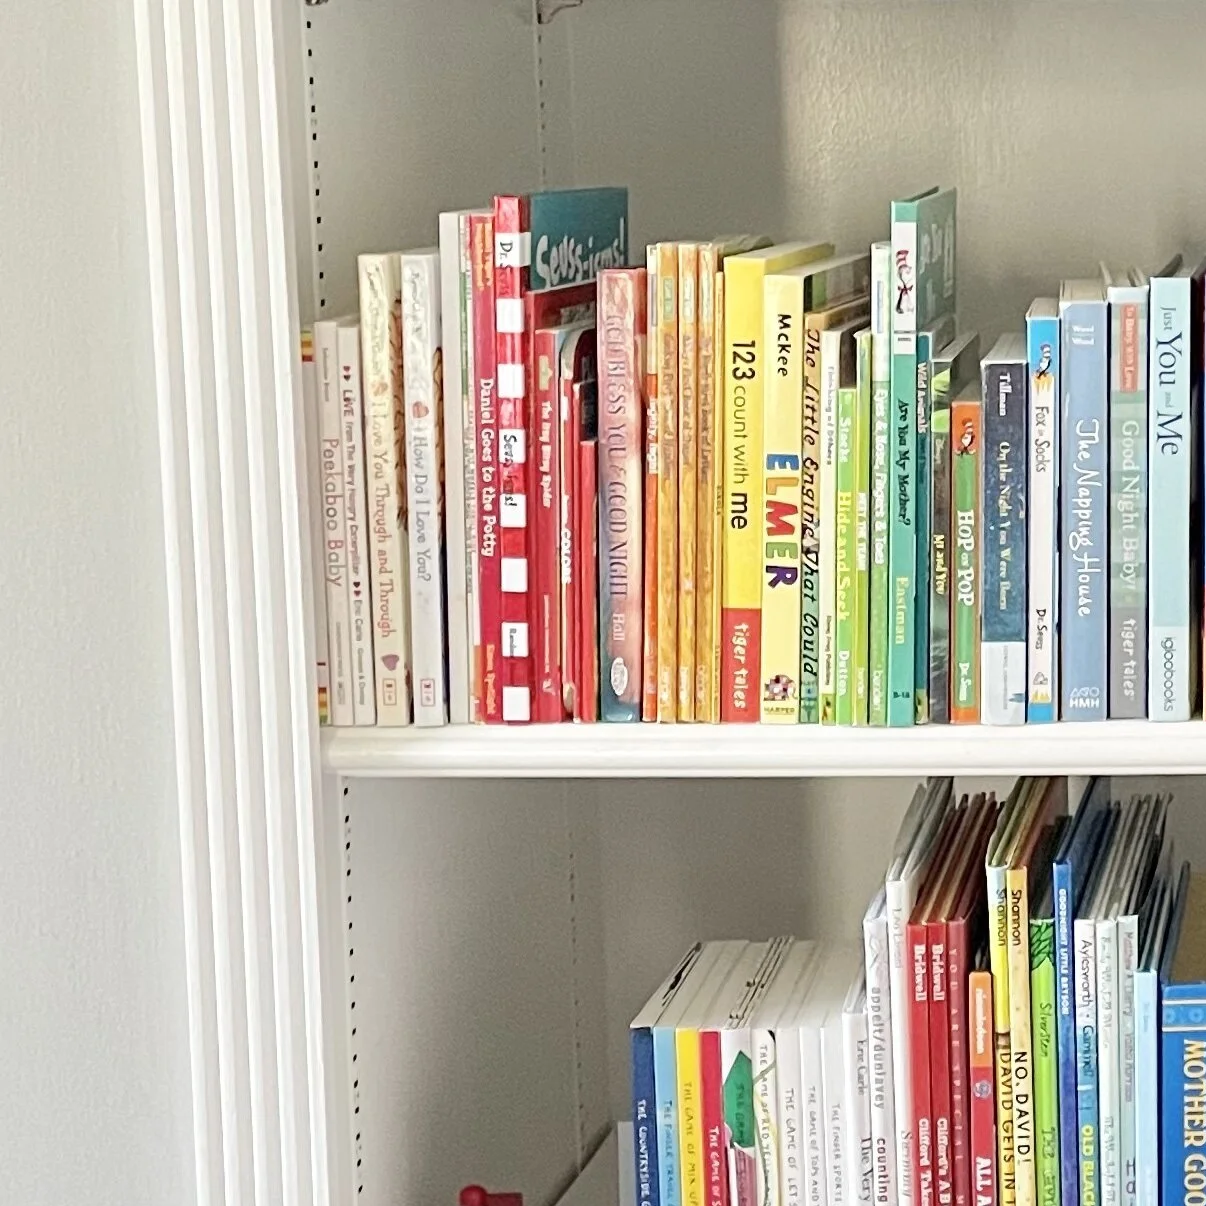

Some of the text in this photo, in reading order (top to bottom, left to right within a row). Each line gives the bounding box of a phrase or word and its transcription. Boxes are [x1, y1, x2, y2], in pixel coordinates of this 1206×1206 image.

[1160, 306, 1176, 331] Just
[777, 313, 791, 377] McKee
[1156, 332, 1183, 386] You
[999, 372, 1011, 417] Tillman
[373, 414, 389, 447] Love
[414, 436, 431, 469] How
[730, 340, 756, 530] 123 count with me
[997, 440, 1011, 460] On
[1035, 406, 1052, 473] Fox Socks
[1122, 420, 1140, 470] Good
[1158, 410, 1184, 455] Me
[374, 453, 390, 480] You
[416, 473, 431, 495] Do
[479, 378, 497, 557] Daniel Goes to the Potty
[895, 399, 911, 527] Are You My Mother?
[1000, 462, 1012, 481] the
[322, 438, 346, 587] Peekaboo Baby
[373, 484, 393, 544] Through
[765, 453, 799, 588] ELMER
[802, 329, 821, 675] The Little Engine That Could
[998, 484, 1013, 518] Night
[1073, 419, 1101, 617] The Napping House
[1118, 476, 1140, 531] Night
[416, 511, 431, 544] Love
[1001, 521, 1014, 544] You
[378, 549, 393, 575] and
[417, 549, 432, 581] You?
[957, 510, 976, 606] HOP POP
[378, 579, 397, 638] Through
[895, 576, 910, 645] Eastman
[1035, 608, 1047, 650] Dr. Seuss
[731, 622, 750, 708] tiger tales
[1121, 619, 1137, 697] tiger tales
[1162, 637, 1177, 712] igloobooks
[1011, 889, 1023, 946] Shannon
[915, 944, 925, 1001] Bridwell
[785, 1088, 795, 1112] THE
[999, 1051, 1013, 1113] DAVID
[637, 1099, 648, 1120] THE
[786, 1115, 796, 1147] GAME
[1015, 1095, 1030, 1163] DAVID!
[709, 1126, 720, 1147] THE
[861, 1137, 874, 1166] The
[918, 1118, 931, 1167] Clifford
[1002, 1119, 1014, 1166] GETS
[1082, 1125, 1096, 1156] OLD
[637, 1125, 649, 1197] COUNTRYSIDE
[710, 1150, 721, 1184] GAME
[786, 1152, 796, 1169] OF
[976, 1156, 992, 1189] ALL
[1003, 1171, 1015, 1190] IN
[711, 1186, 722, 1197] OF
[860, 1169, 874, 1201] Very
